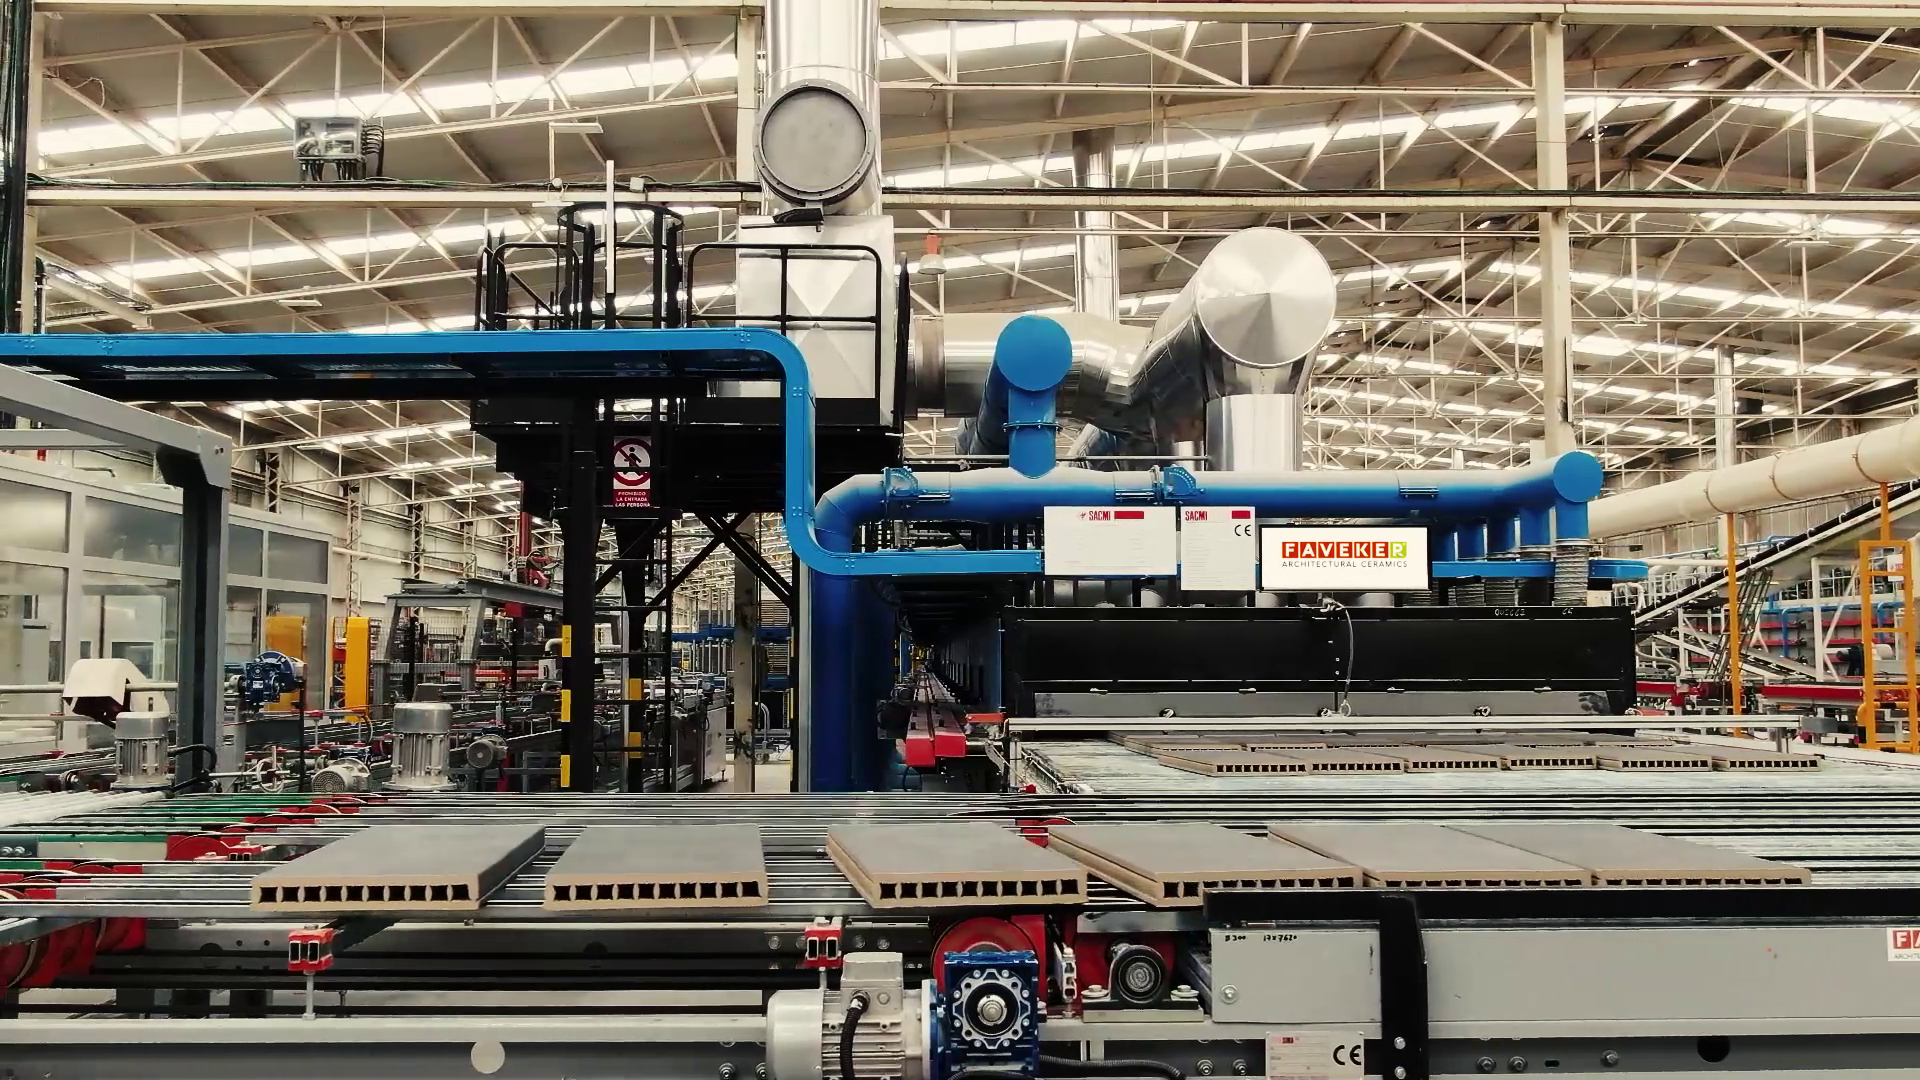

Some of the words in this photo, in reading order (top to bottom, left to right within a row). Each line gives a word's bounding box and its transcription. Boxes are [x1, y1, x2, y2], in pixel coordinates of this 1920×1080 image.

[1089, 511, 1111, 520] SACMI
[1185, 511, 1208, 520] SACMI
[1283, 542, 1406, 558] FAVEKER
